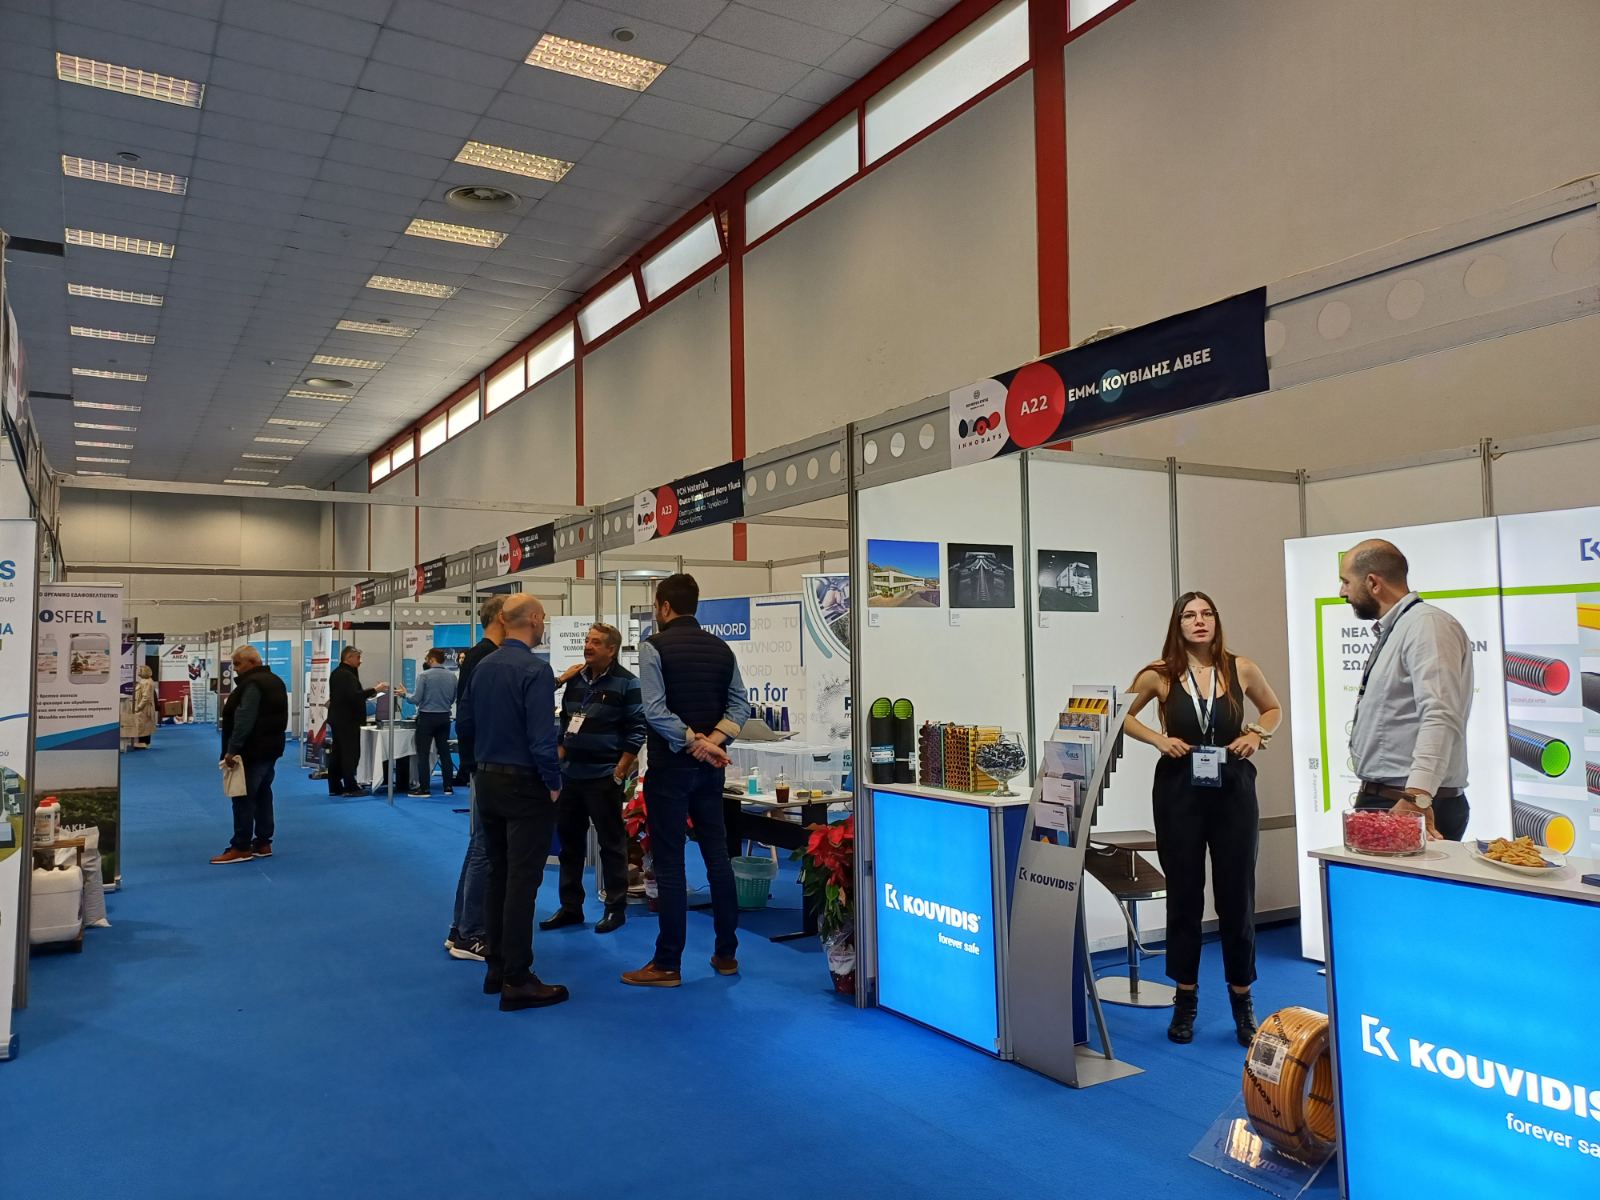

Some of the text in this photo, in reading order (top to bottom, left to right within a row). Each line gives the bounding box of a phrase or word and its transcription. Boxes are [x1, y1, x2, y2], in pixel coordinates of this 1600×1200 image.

[1068, 347, 1211, 402] ΕΜΜ. ΚΟΥΒΙΔΗΣ ΑΒΕΕ
[1020, 395, 1048, 416] A22
[661, 504, 672, 516] A23
[1341, 626, 1369, 638] ΝΕΑ
[764, 682, 788, 702] for
[1030, 872, 1075, 891] KOUVIDIS
[903, 895, 979, 933] KOUVIDIS
[938, 932, 980, 956] forever safe
[1505, 1112, 1573, 1149] forever
